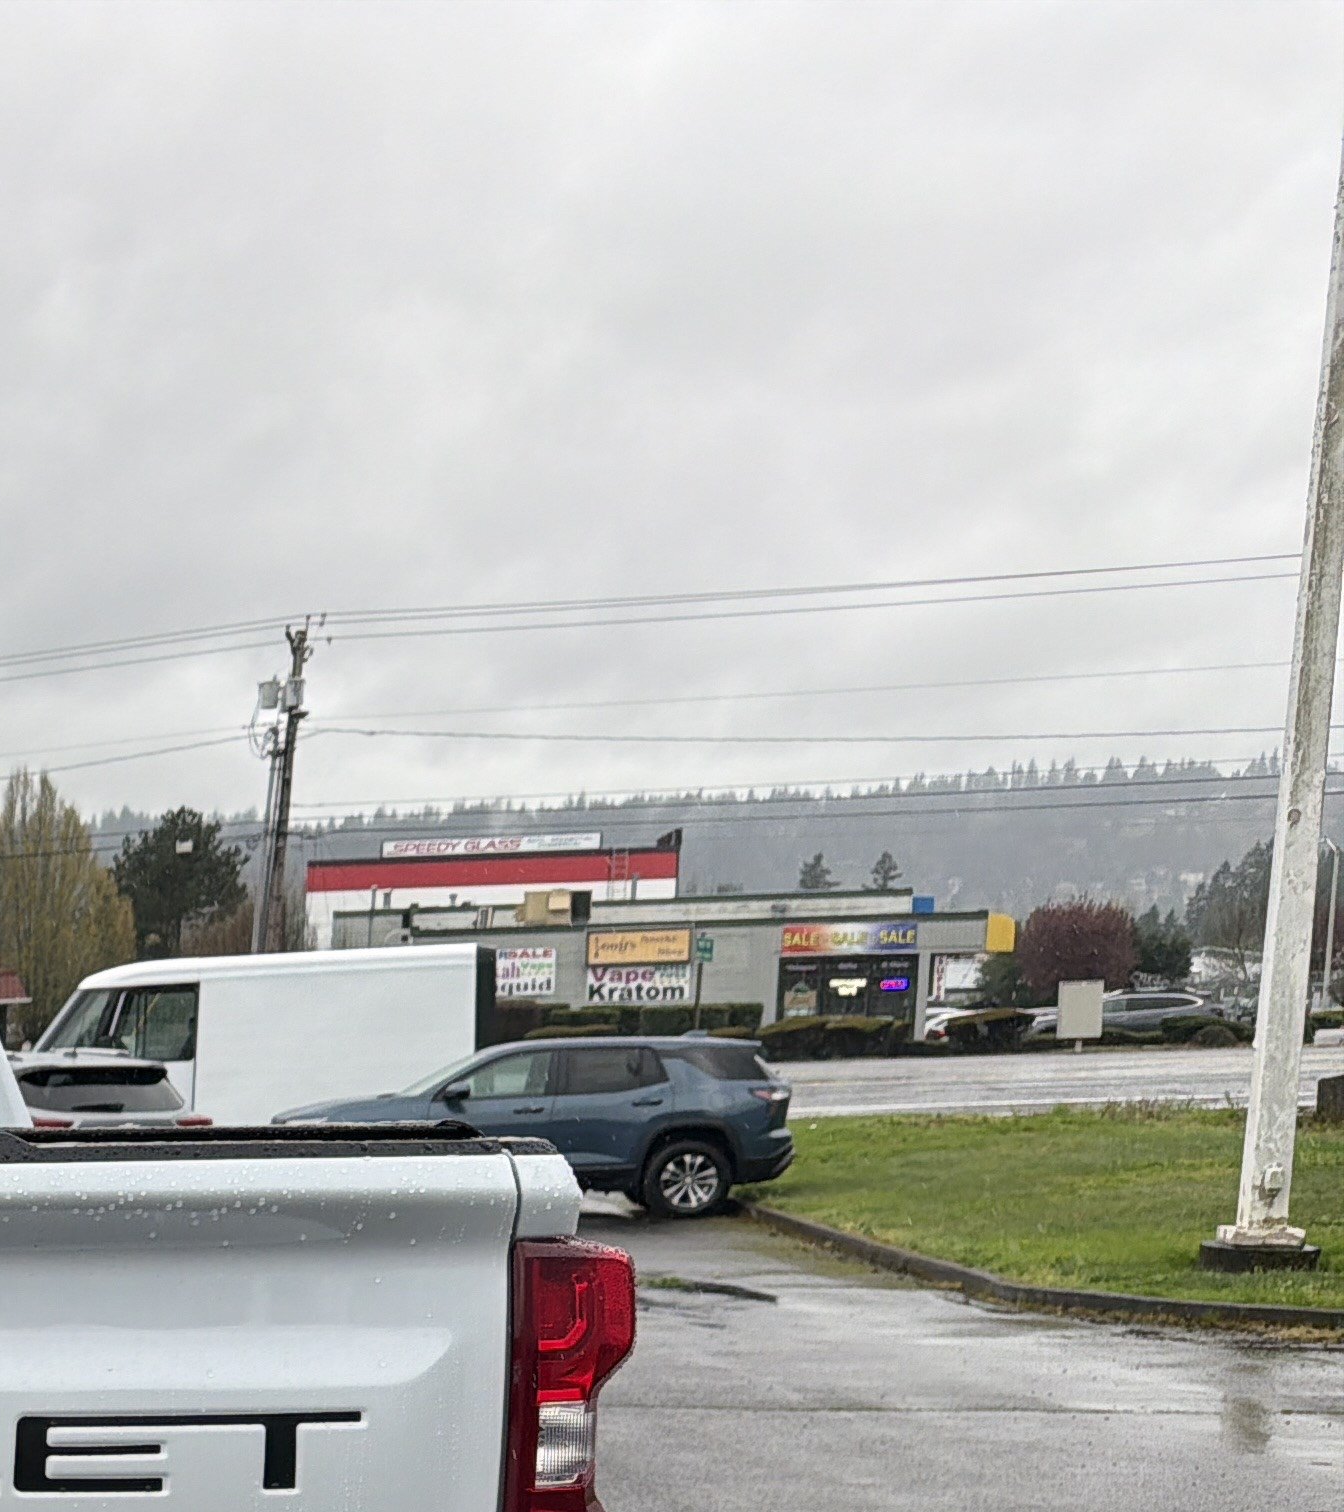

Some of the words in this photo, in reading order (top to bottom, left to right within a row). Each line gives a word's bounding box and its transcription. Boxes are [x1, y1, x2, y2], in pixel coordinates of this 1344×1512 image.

[392, 840, 460, 853] SPEEDY
[463, 836, 522, 851] GLASS
[783, 931, 819, 946] SALE
[880, 929, 915, 945] SALE
[591, 964, 655, 985] Vape
[498, 977, 552, 997] quid
[588, 982, 684, 1001] Kratom
